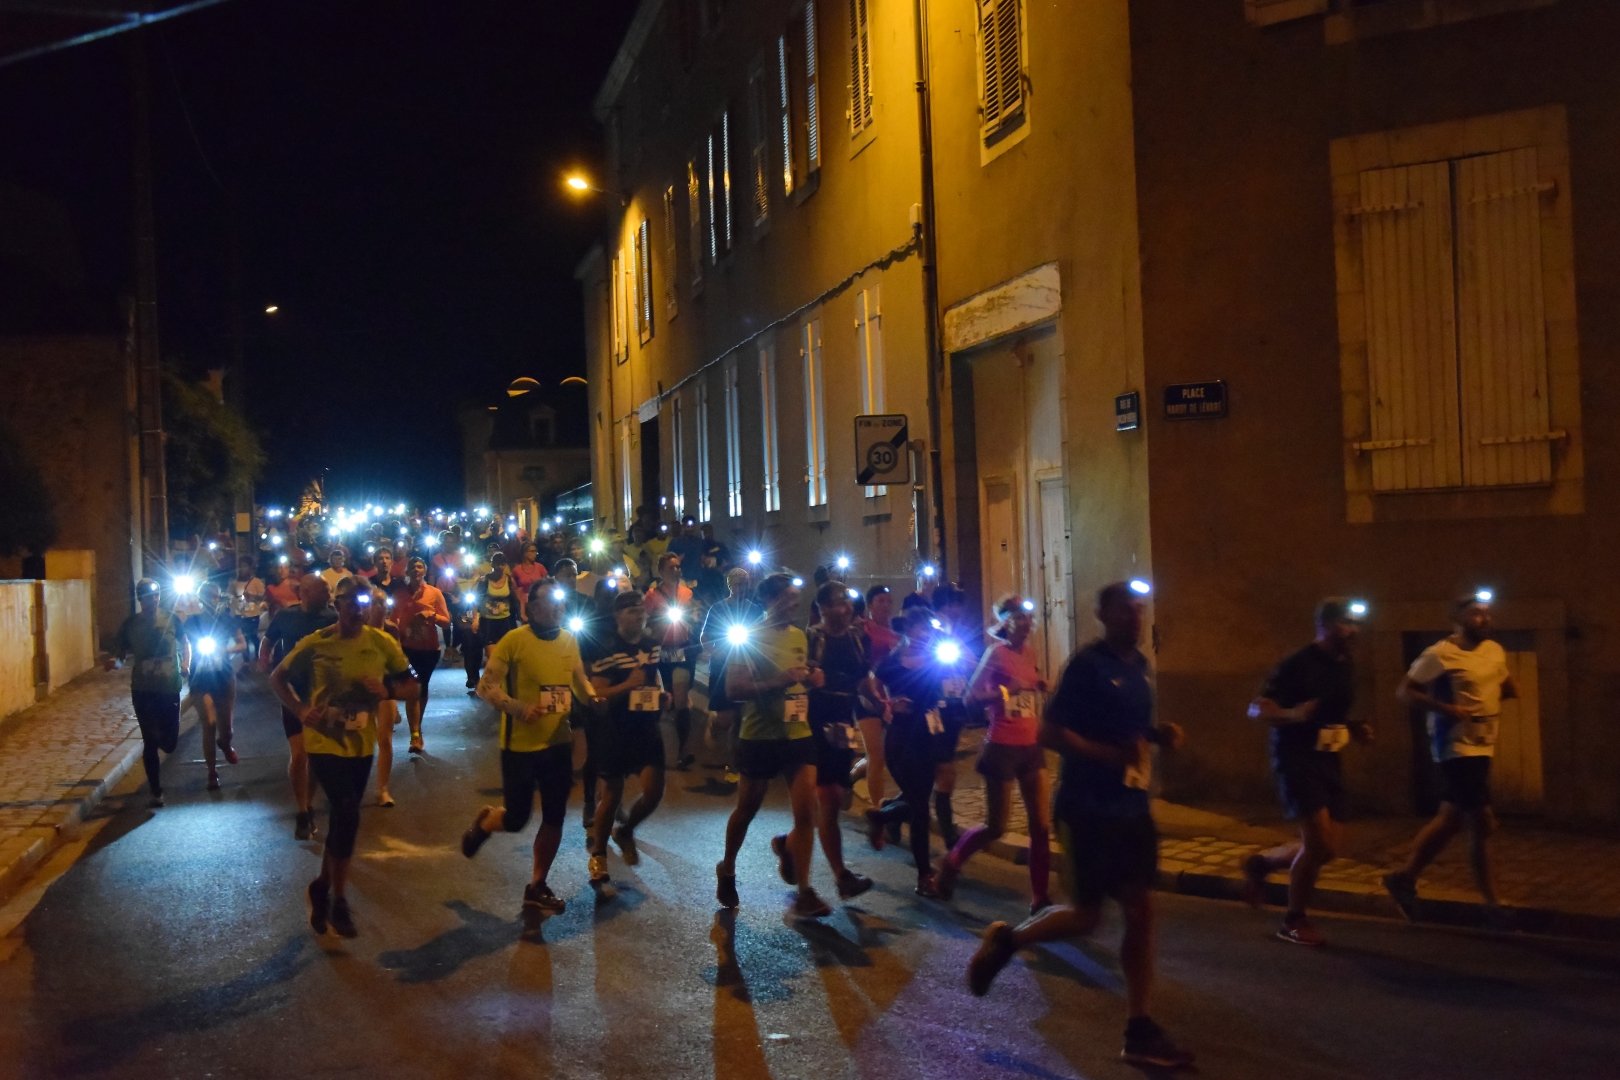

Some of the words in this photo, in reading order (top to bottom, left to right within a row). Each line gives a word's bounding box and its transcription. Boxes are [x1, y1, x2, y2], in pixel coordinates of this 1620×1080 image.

[1182, 387, 1205, 398] PLACE
[873, 451, 892, 465] 30
[551, 692, 565, 704] 570
